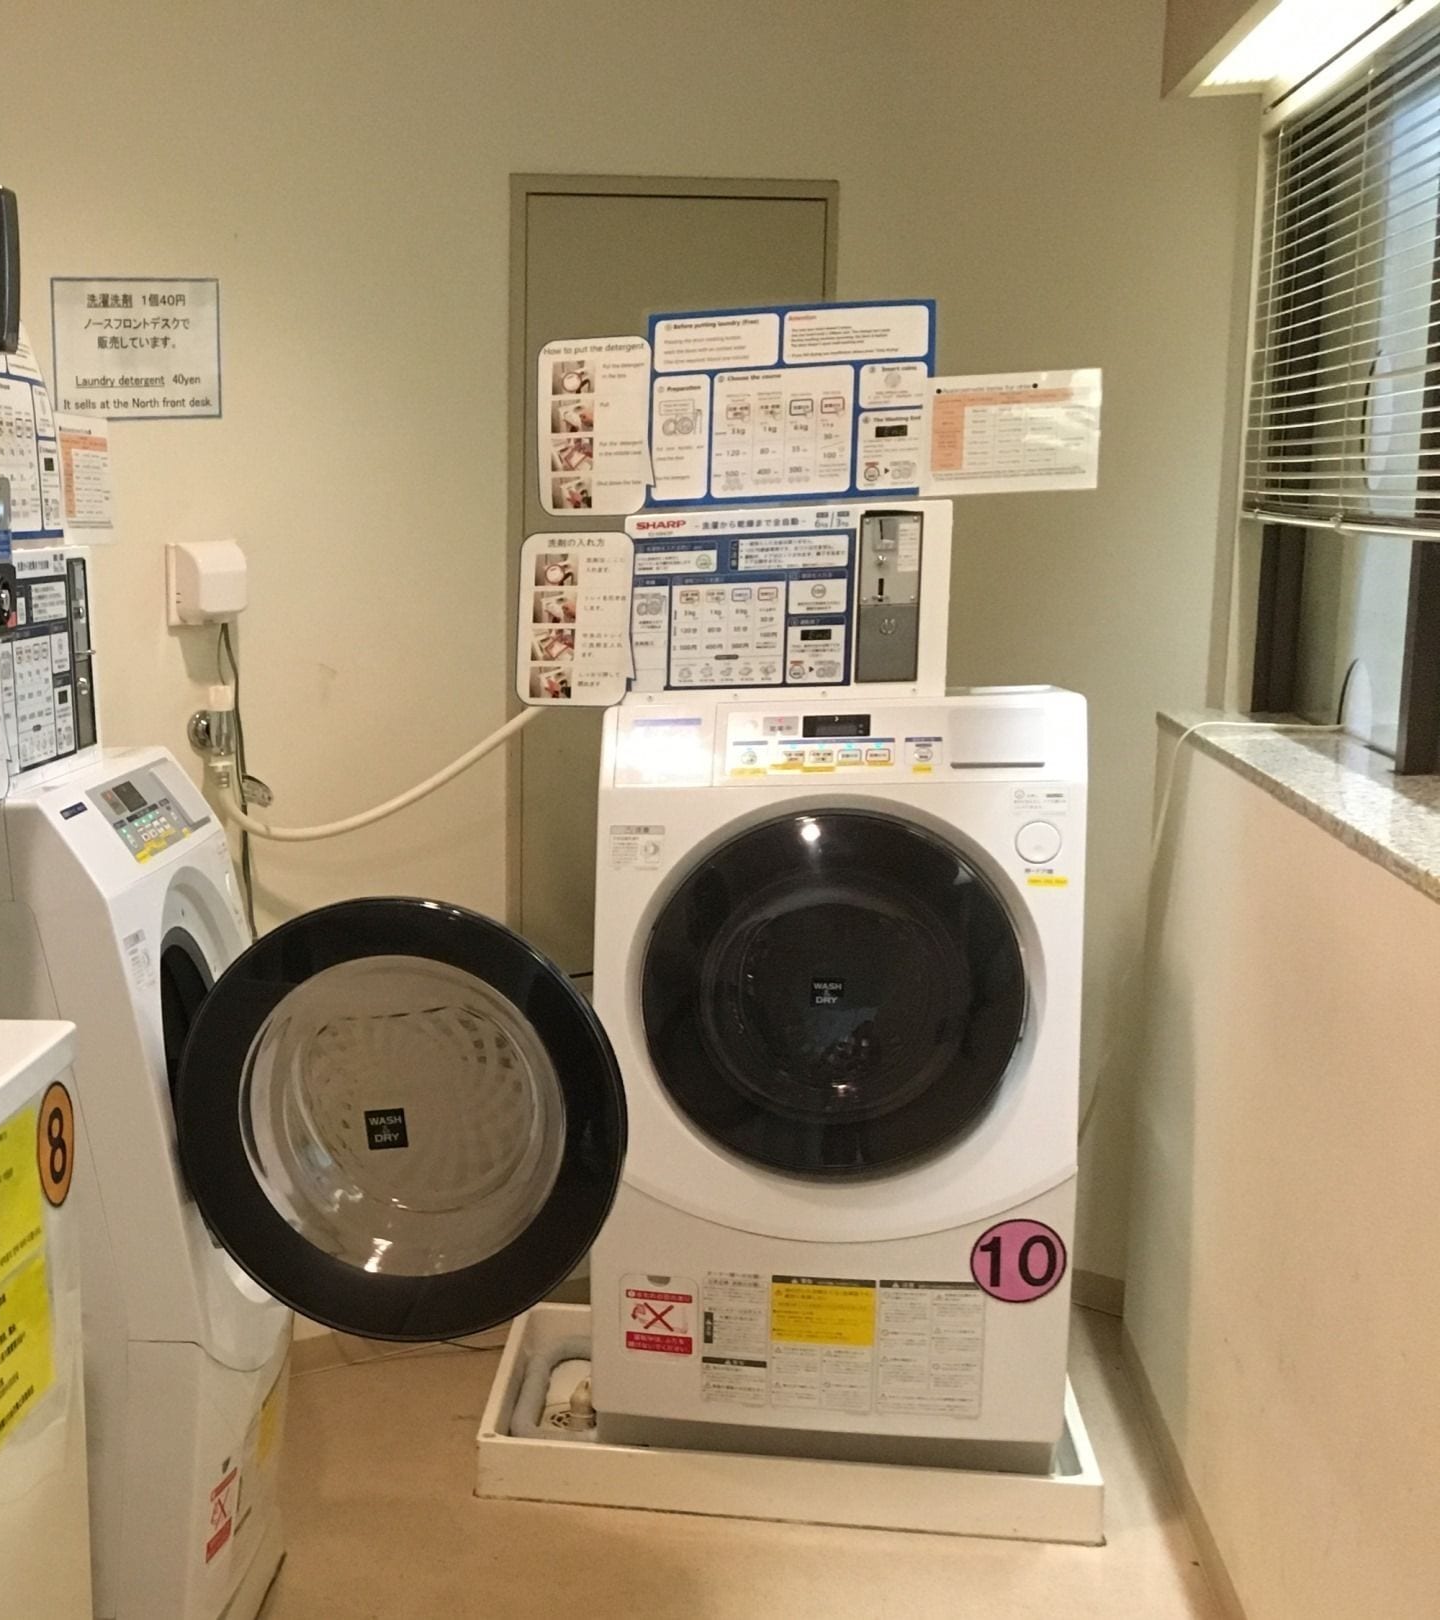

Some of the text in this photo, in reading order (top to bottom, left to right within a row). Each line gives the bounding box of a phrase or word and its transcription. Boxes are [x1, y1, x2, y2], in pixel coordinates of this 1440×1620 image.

[87, 293, 186, 307] 洗濯洗剤 1個40円
[84, 317, 190, 330] ノースフロントデスクで
[97, 336, 177, 349] 販売しています。
[543, 342, 644, 356] How to put the detergent
[76, 374, 201, 388] Laundry detergent 40yen
[64, 399, 71, 410] It
[75, 398, 96, 410] sells
[100, 400, 109, 409] at
[113, 398, 129, 409] the
[132, 398, 159, 408] North
[163, 397, 186, 408] front
[636, 518, 686, 533] SHARP
[813, 982, 842, 991] WASH
[815, 996, 838, 1004] DRY
[368, 1115, 402, 1126] WASH
[374, 1133, 399, 1143] DRY
[47, 1106, 68, 1184] 8
[978, 1235, 1059, 1290] 10
